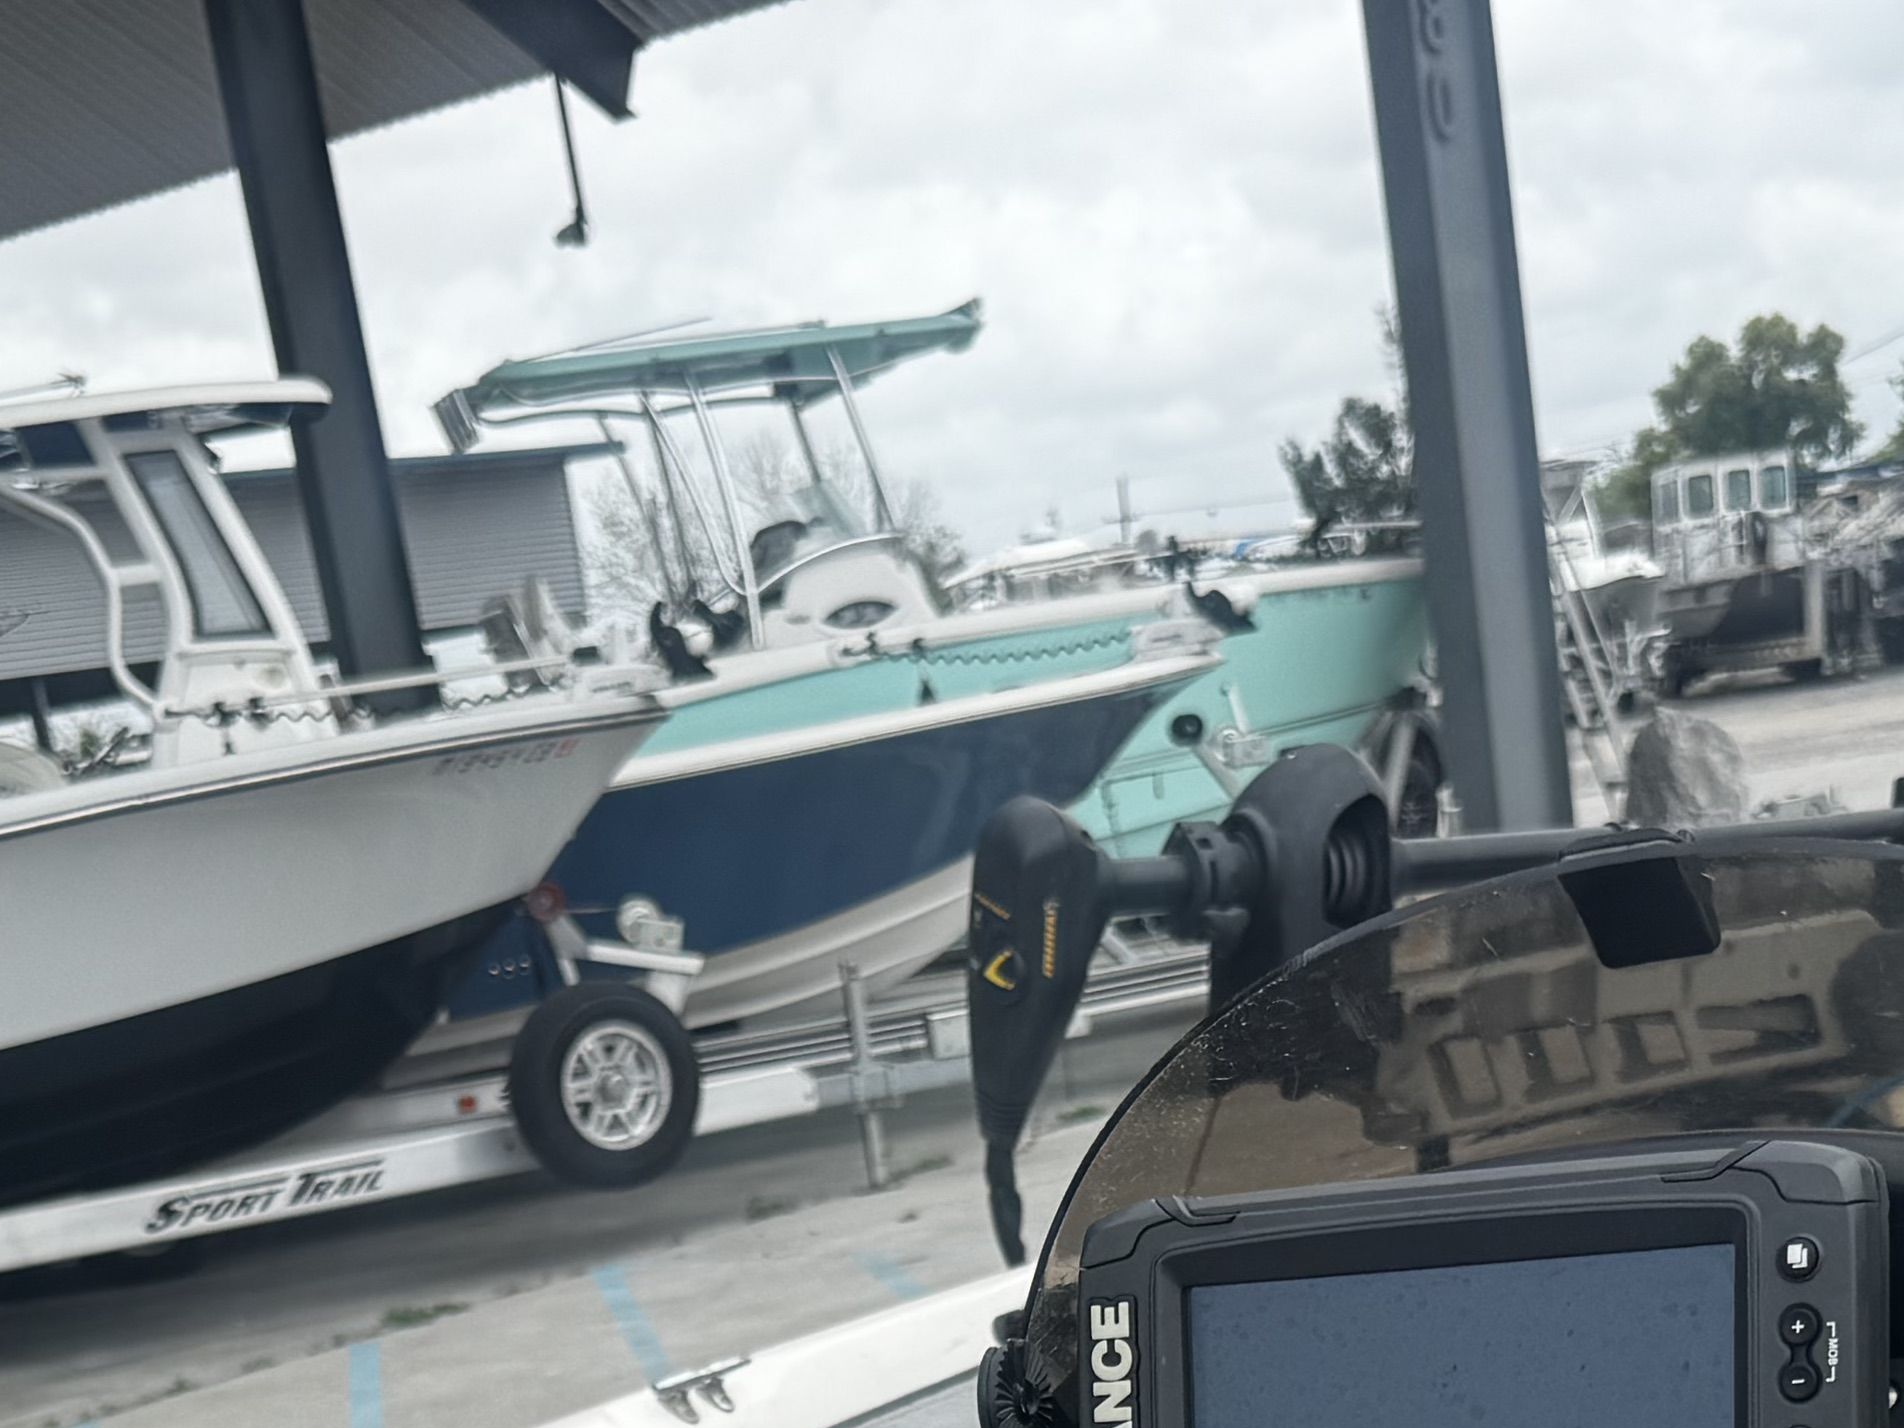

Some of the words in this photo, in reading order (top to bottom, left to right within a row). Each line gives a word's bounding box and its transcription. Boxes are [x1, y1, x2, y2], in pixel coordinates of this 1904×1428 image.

[145, 1178, 290, 1235] SPORT
[288, 1158, 385, 1207] TRAIL
[1828, 1338, 1838, 1366] MOB
